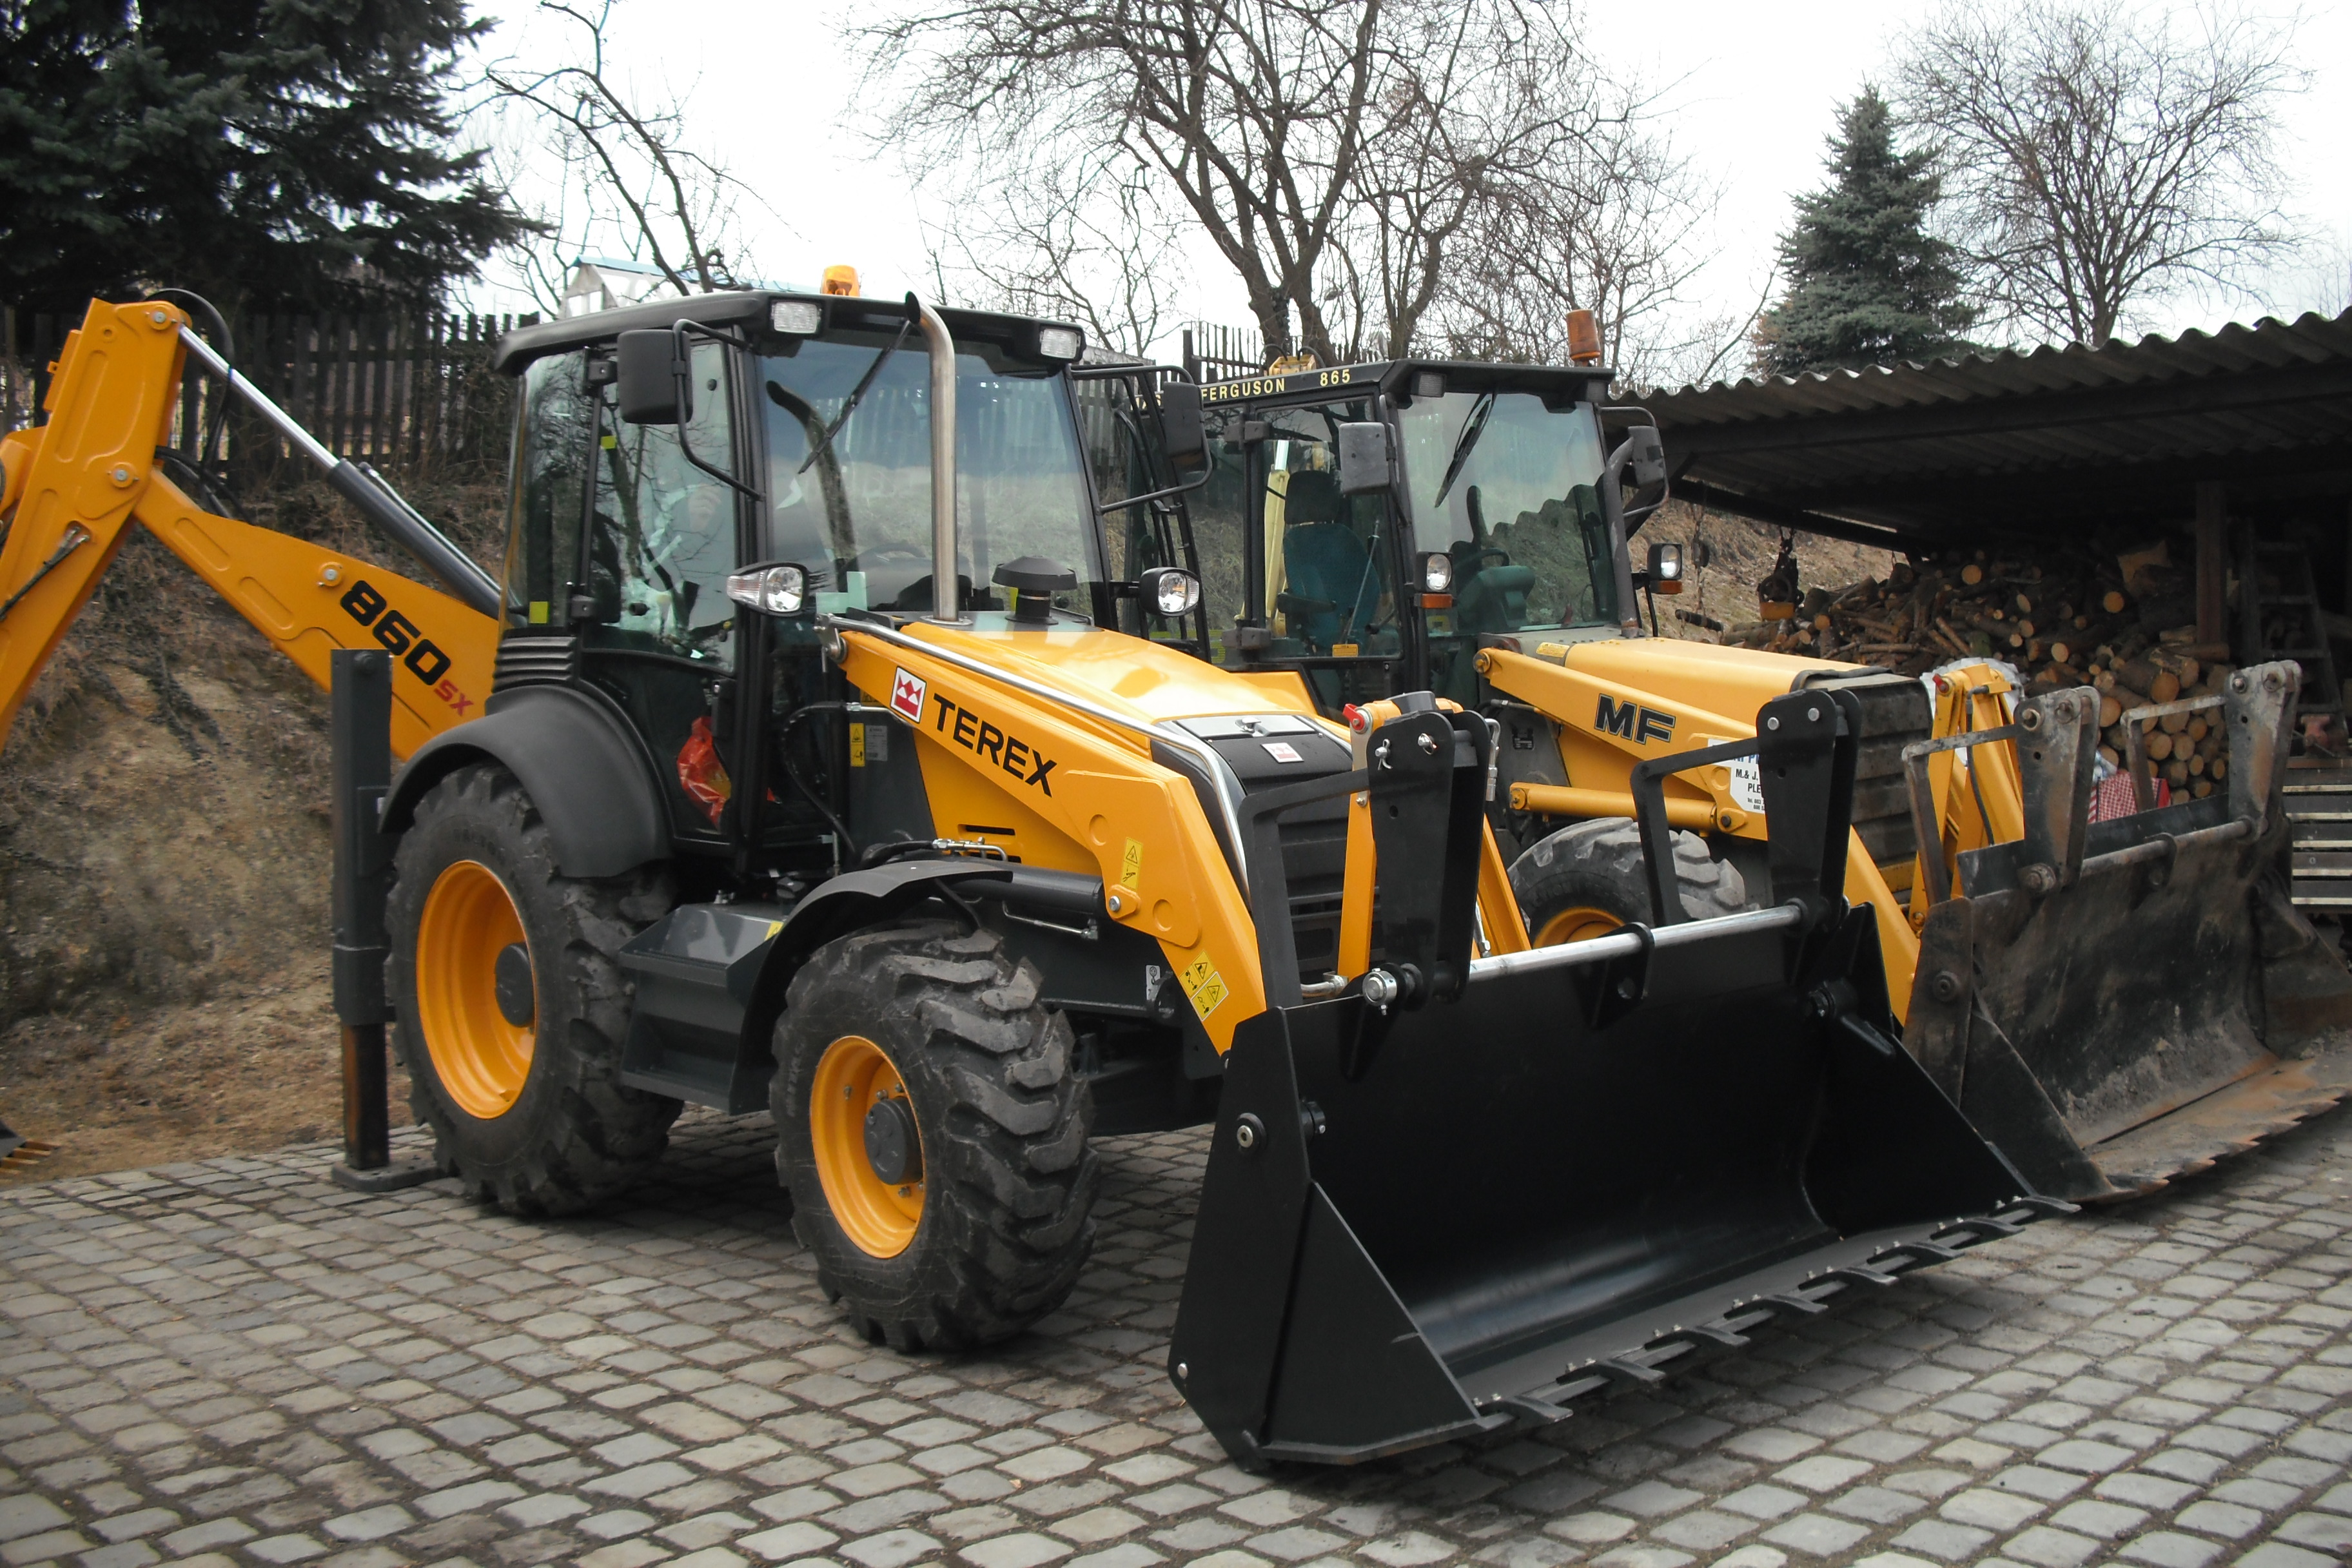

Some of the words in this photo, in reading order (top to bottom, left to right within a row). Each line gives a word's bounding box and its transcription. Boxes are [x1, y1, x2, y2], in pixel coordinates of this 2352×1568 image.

[1201, 378, 1285, 401] FERGUSON
[1320, 369, 1350, 386] 865
[340, 580, 451, 685] 860
[434, 679, 474, 716] SX
[933, 692, 1057, 797] TEREX
[1594, 693, 1676, 745] MF
